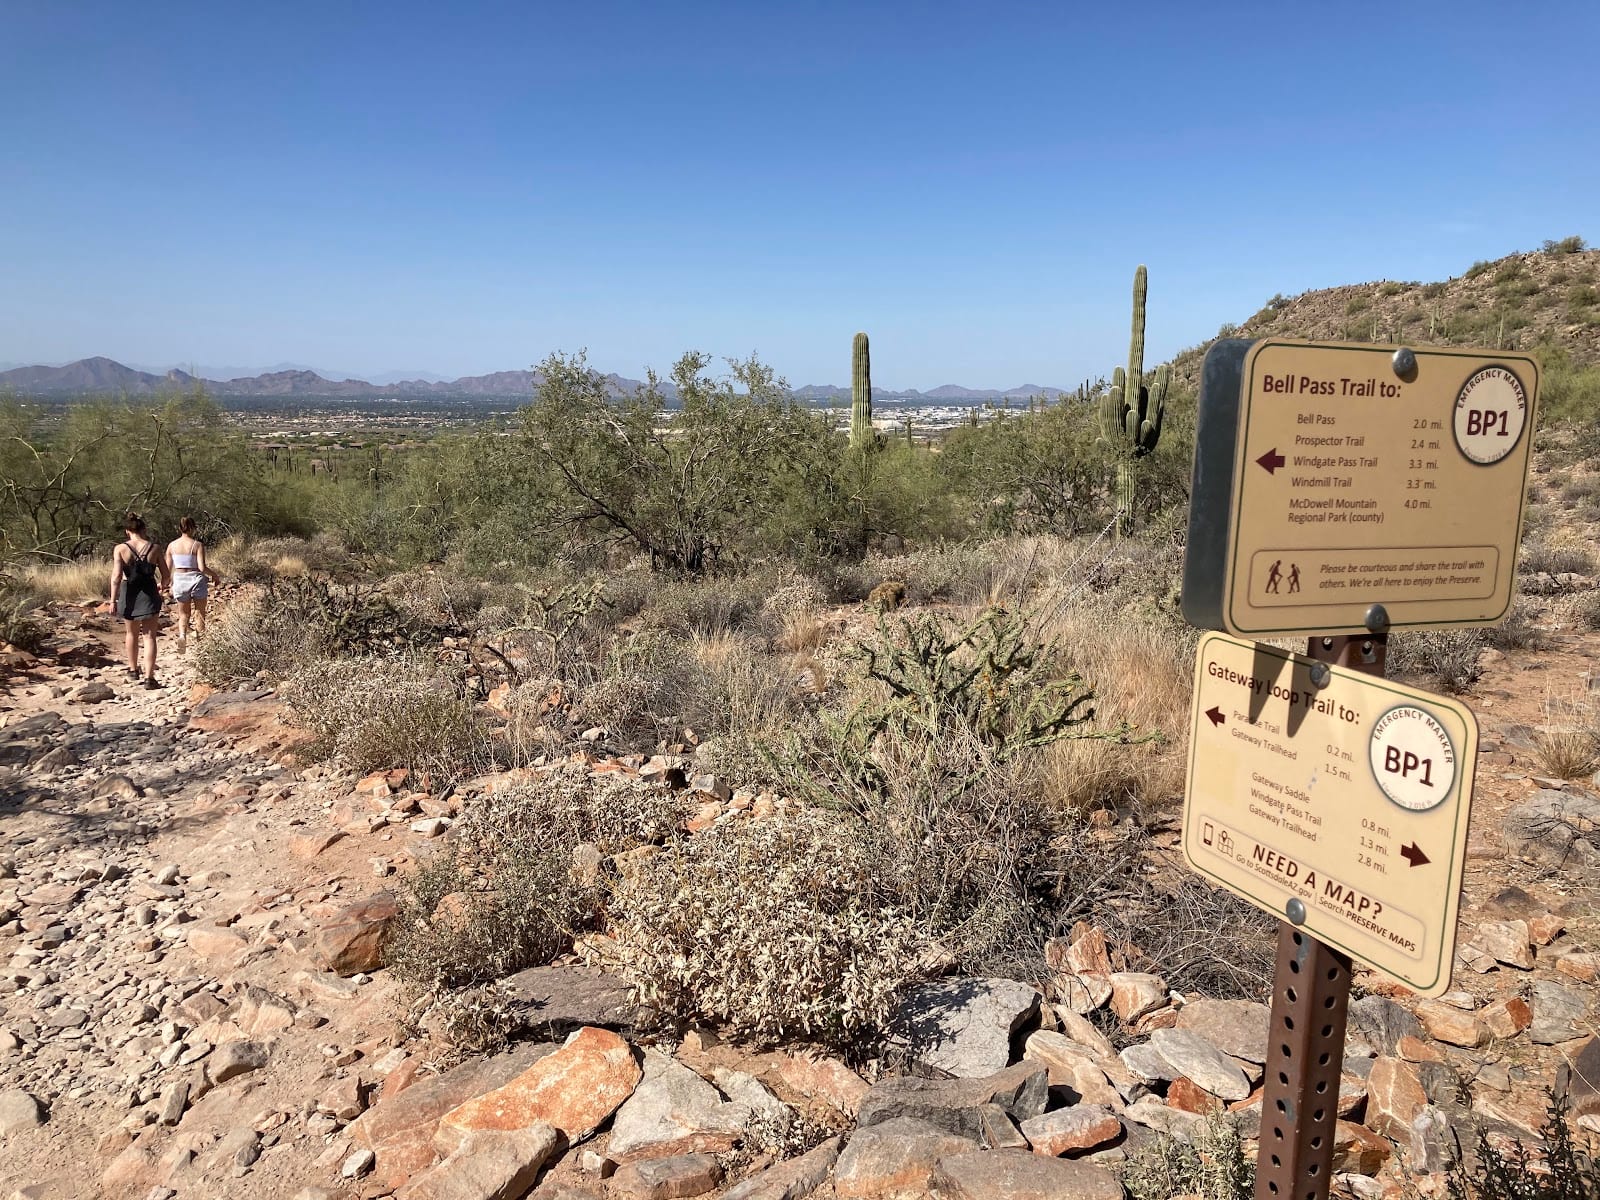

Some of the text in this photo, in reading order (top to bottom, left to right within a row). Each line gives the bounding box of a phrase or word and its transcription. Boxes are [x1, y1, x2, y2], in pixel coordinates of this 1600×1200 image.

[1263, 374, 1402, 398] Bell Pass Trail to:
[1457, 369, 1525, 410] EMERGENCY MARKER
[1296, 413, 1336, 425] Bell Pass
[1413, 419, 1444, 430] 2.0 mi.
[1466, 409, 1509, 437] BP1
[1295, 434, 1365, 448] Prospector Trail
[1411, 440, 1441, 450] 2.4 mi.
[1293, 456, 1378, 469] Windgate Pass Trail
[1409, 459, 1440, 470] 3.3 mi.
[1291, 477, 1352, 488] Windmill Trail
[1406, 479, 1437, 490] 3.3 mi.
[1289, 499, 1378, 509] McDowell Mountain
[1404, 499, 1432, 509] 4.0 mi.
[1288, 512, 1385, 525] Regional Park (county)
[1320, 559, 1485, 574] Please be courteous and share the trail with
[1319, 575, 1482, 589] others. We're all here to enjoy the Preserve.
[1208, 661, 1361, 725] Gateway Loop Trail to:
[1233, 710, 1281, 736] Parase Trail
[1231, 727, 1298, 762] Gateway Trailhead
[1374, 709, 1453, 764] EMERGENCY MARKER
[1326, 743, 1355, 764] 0.2 mi.
[1325, 763, 1353, 783] 1.5 mi.
[1384, 744, 1434, 788] BP1
[1252, 771, 1311, 804] Gateway Saddle
[1250, 787, 1323, 827] Windgate Pass Trail
[1249, 804, 1317, 842] Gateway Trailhead
[1361, 818, 1392, 840] 0.8 mi.
[1360, 835, 1390, 857] 1.3 mi.
[1357, 853, 1388, 876] 2.8 mi.
[1252, 843, 1384, 921] NEED A MAP?
[1236, 853, 1417, 953] Go to ScottsdaleAZ.gov Search PRESERVE MAPS
